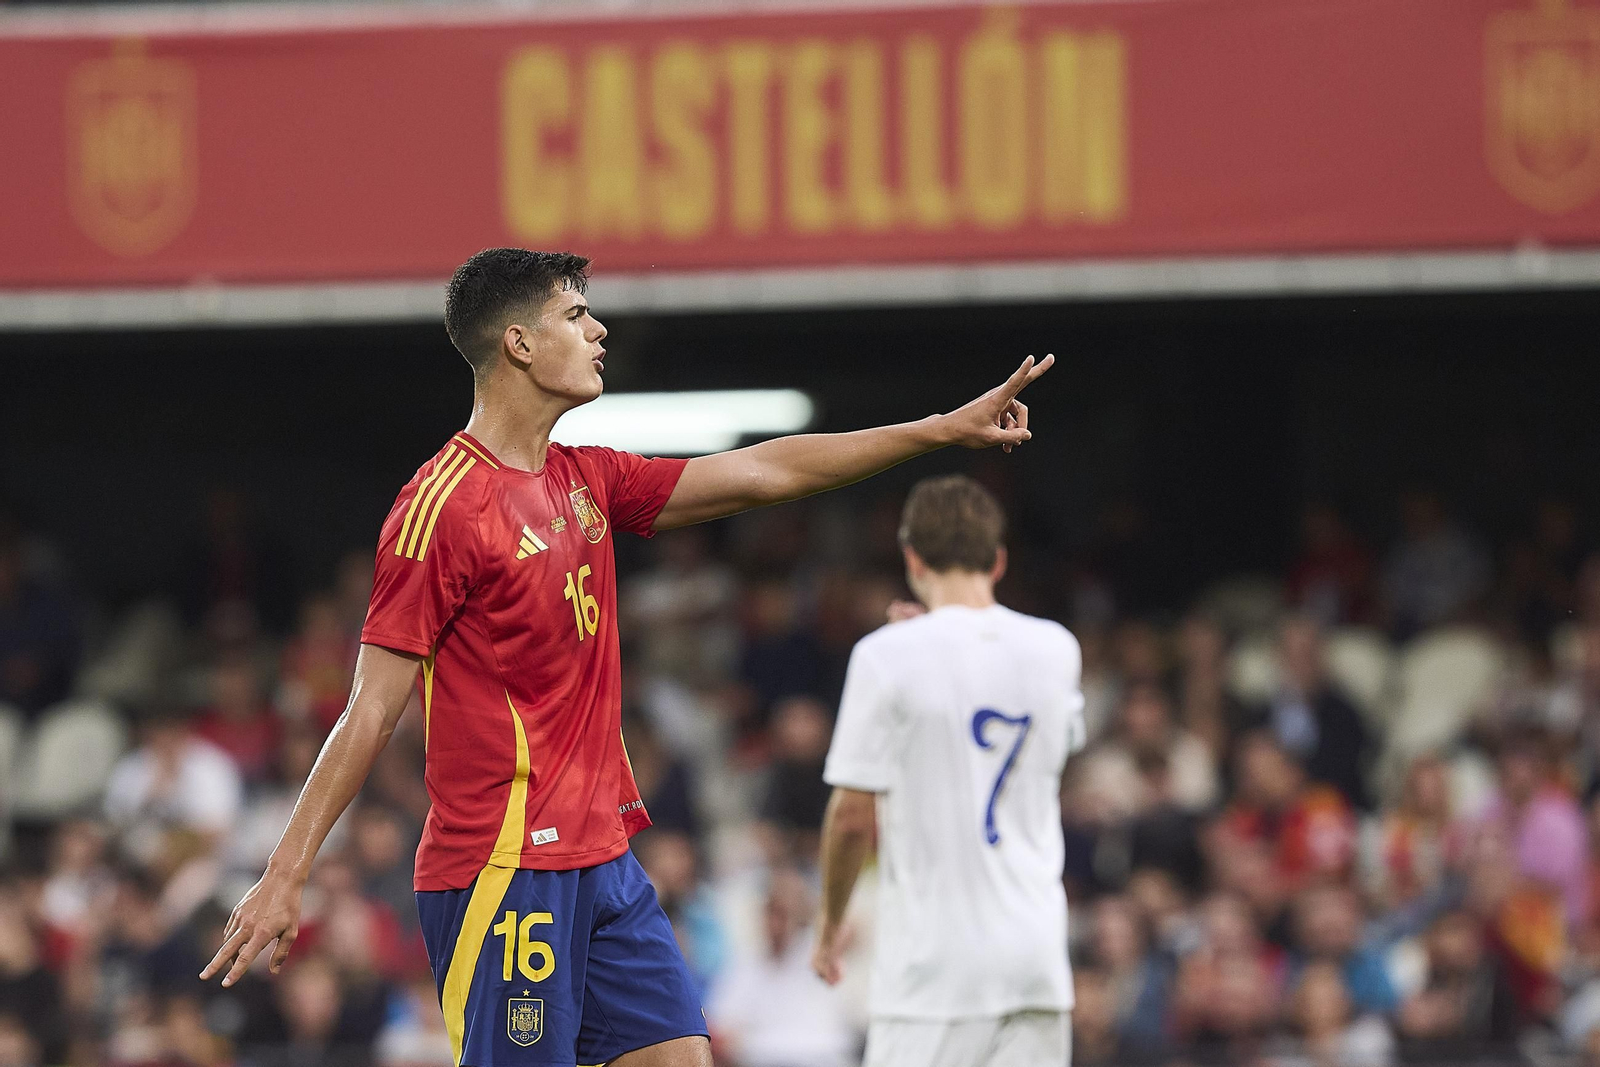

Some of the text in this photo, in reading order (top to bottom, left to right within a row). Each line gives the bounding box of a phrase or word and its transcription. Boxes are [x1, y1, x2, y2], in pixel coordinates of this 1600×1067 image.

[504, 8, 1127, 240] CASTELLÓN
[564, 564, 600, 641] 16
[971, 709, 1031, 844] 7
[493, 911, 556, 983] 16
